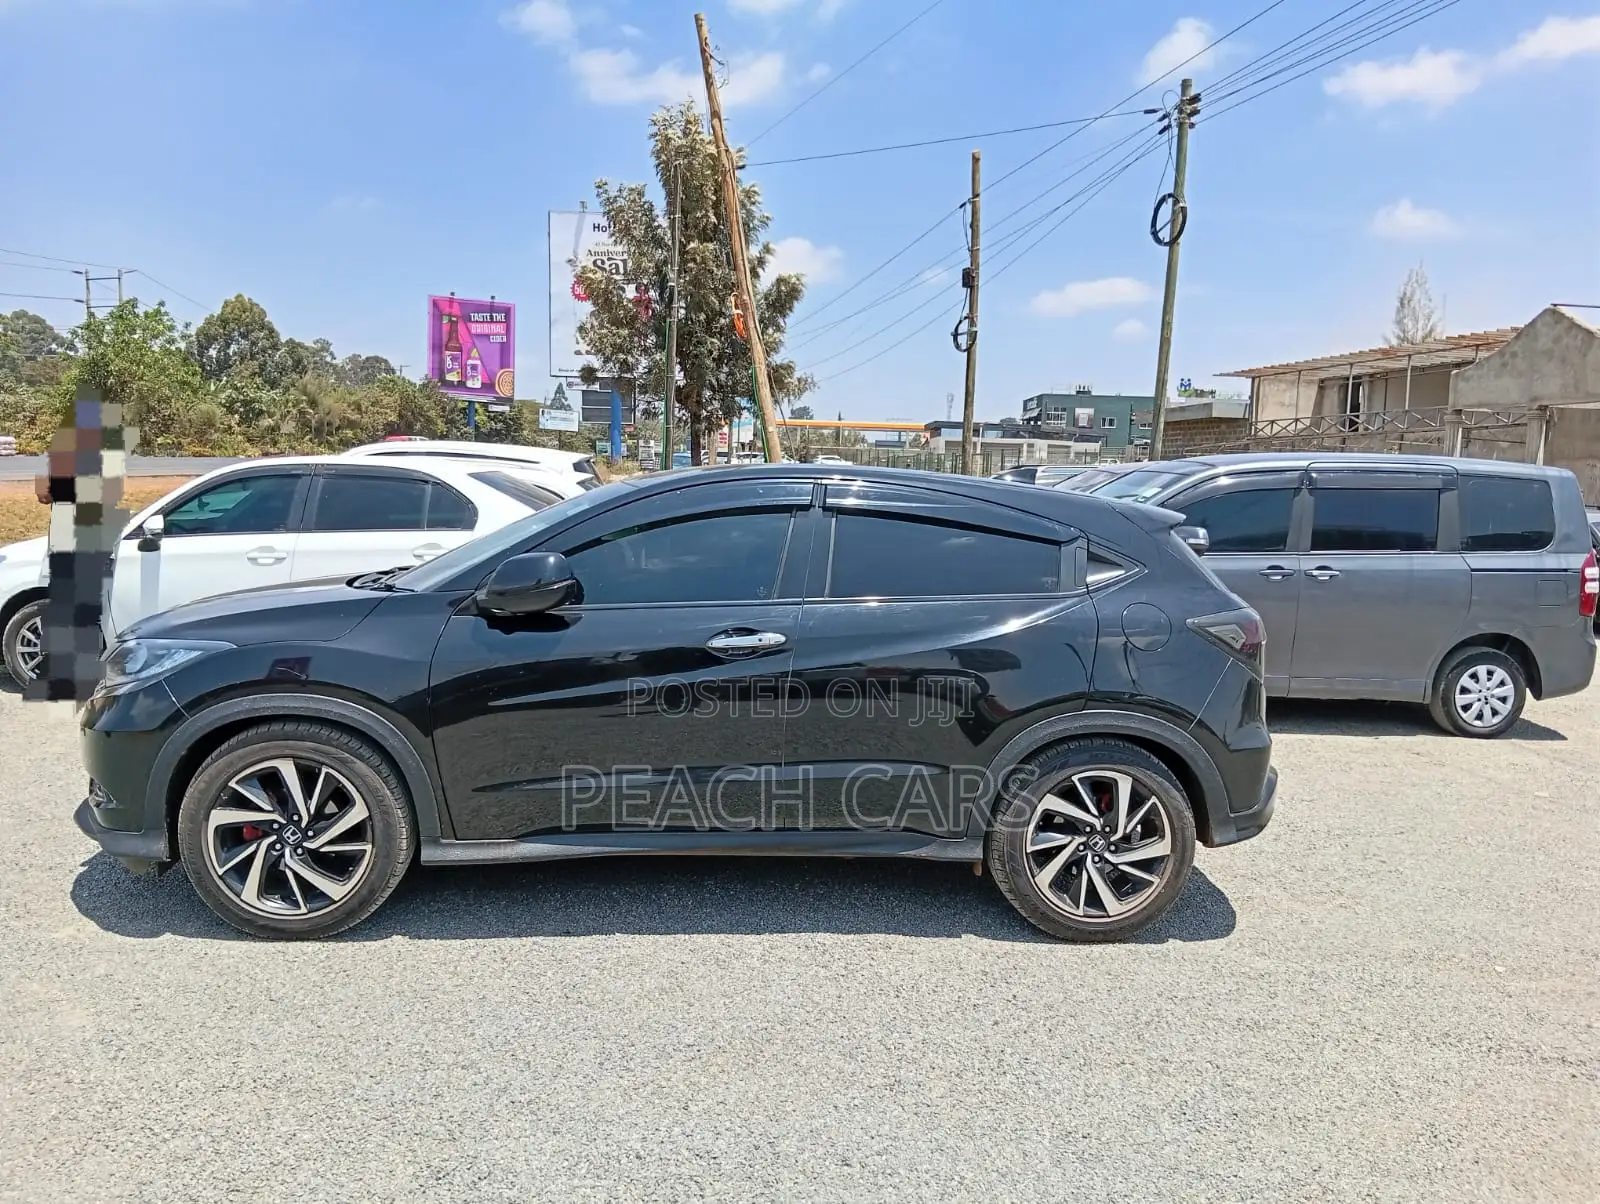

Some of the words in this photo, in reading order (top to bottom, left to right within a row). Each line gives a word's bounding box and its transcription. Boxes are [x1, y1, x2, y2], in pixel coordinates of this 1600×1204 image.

[470, 312, 491, 322] TASTE
[492, 313, 506, 322] THE
[471, 323, 505, 334] ORIGINAL
